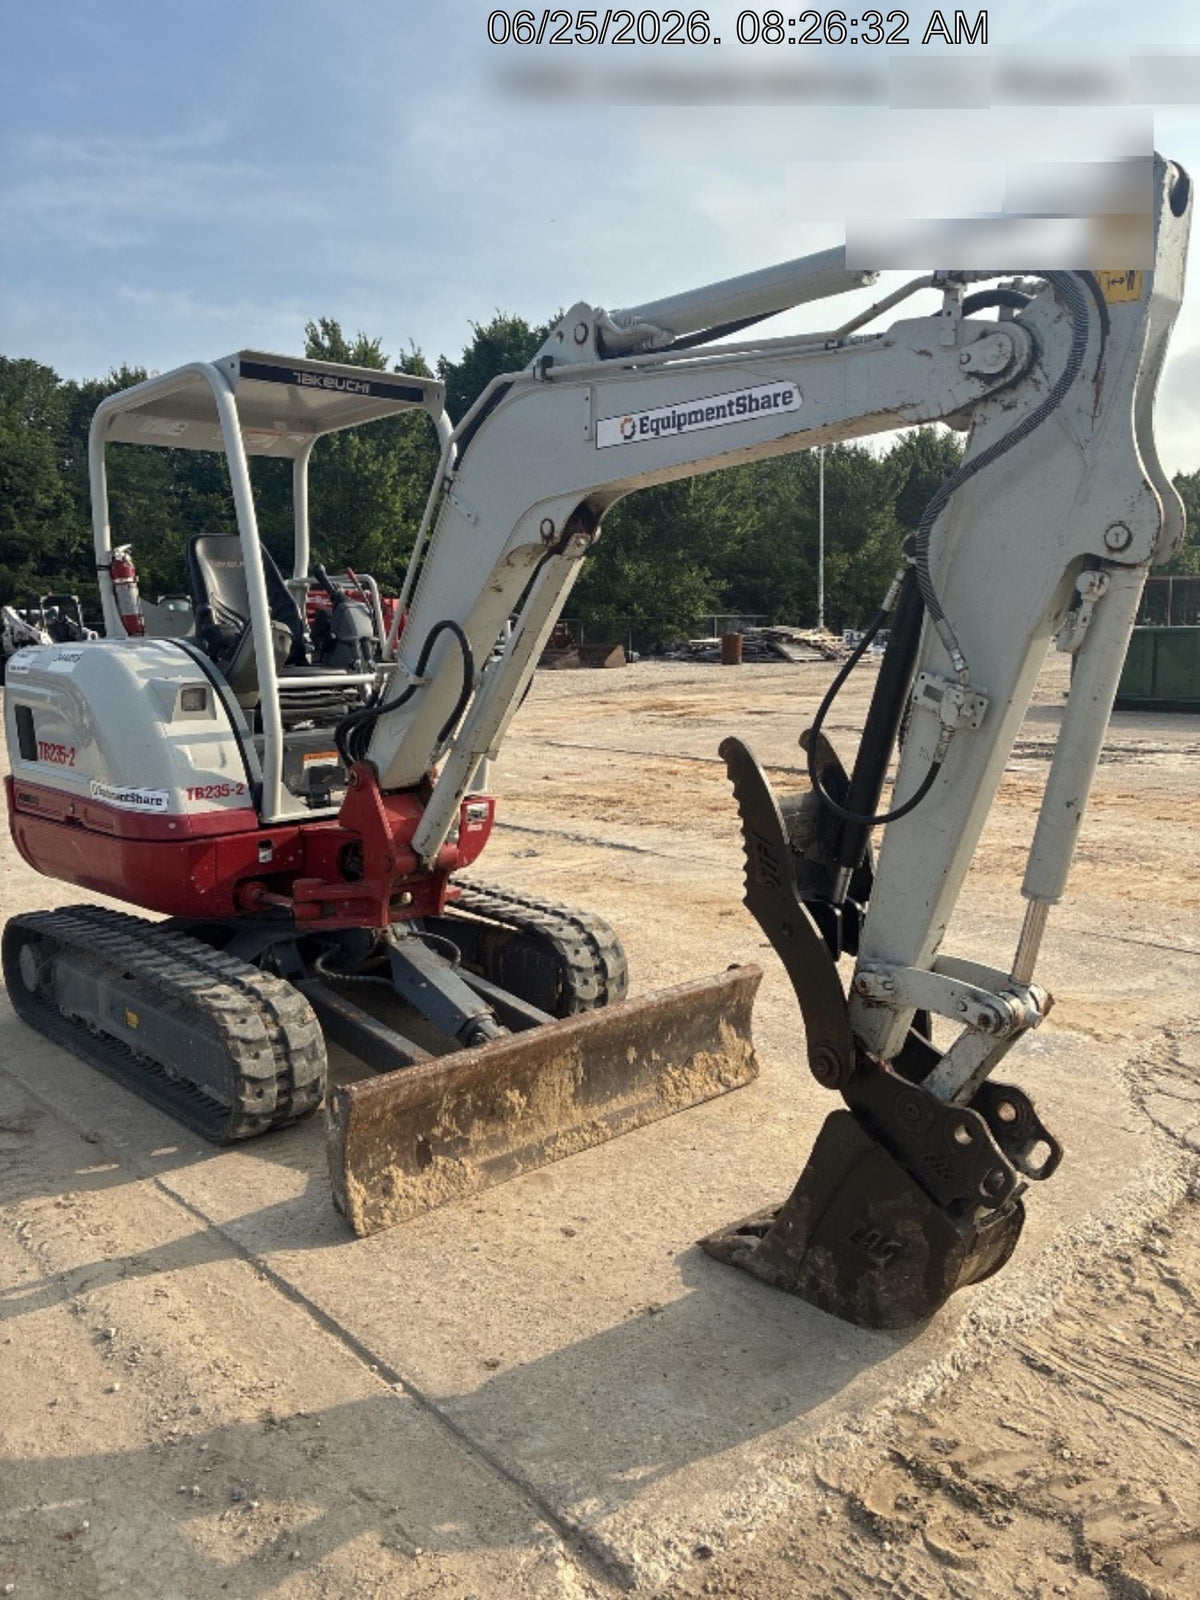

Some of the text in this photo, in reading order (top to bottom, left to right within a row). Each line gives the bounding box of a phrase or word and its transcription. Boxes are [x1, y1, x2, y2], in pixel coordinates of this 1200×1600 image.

[293, 373, 370, 394] TAKEUCHI
[639, 389, 793, 436] EquipmentShare
[38, 741, 76, 767] TB235-2
[186, 782, 245, 801] TB235-2
